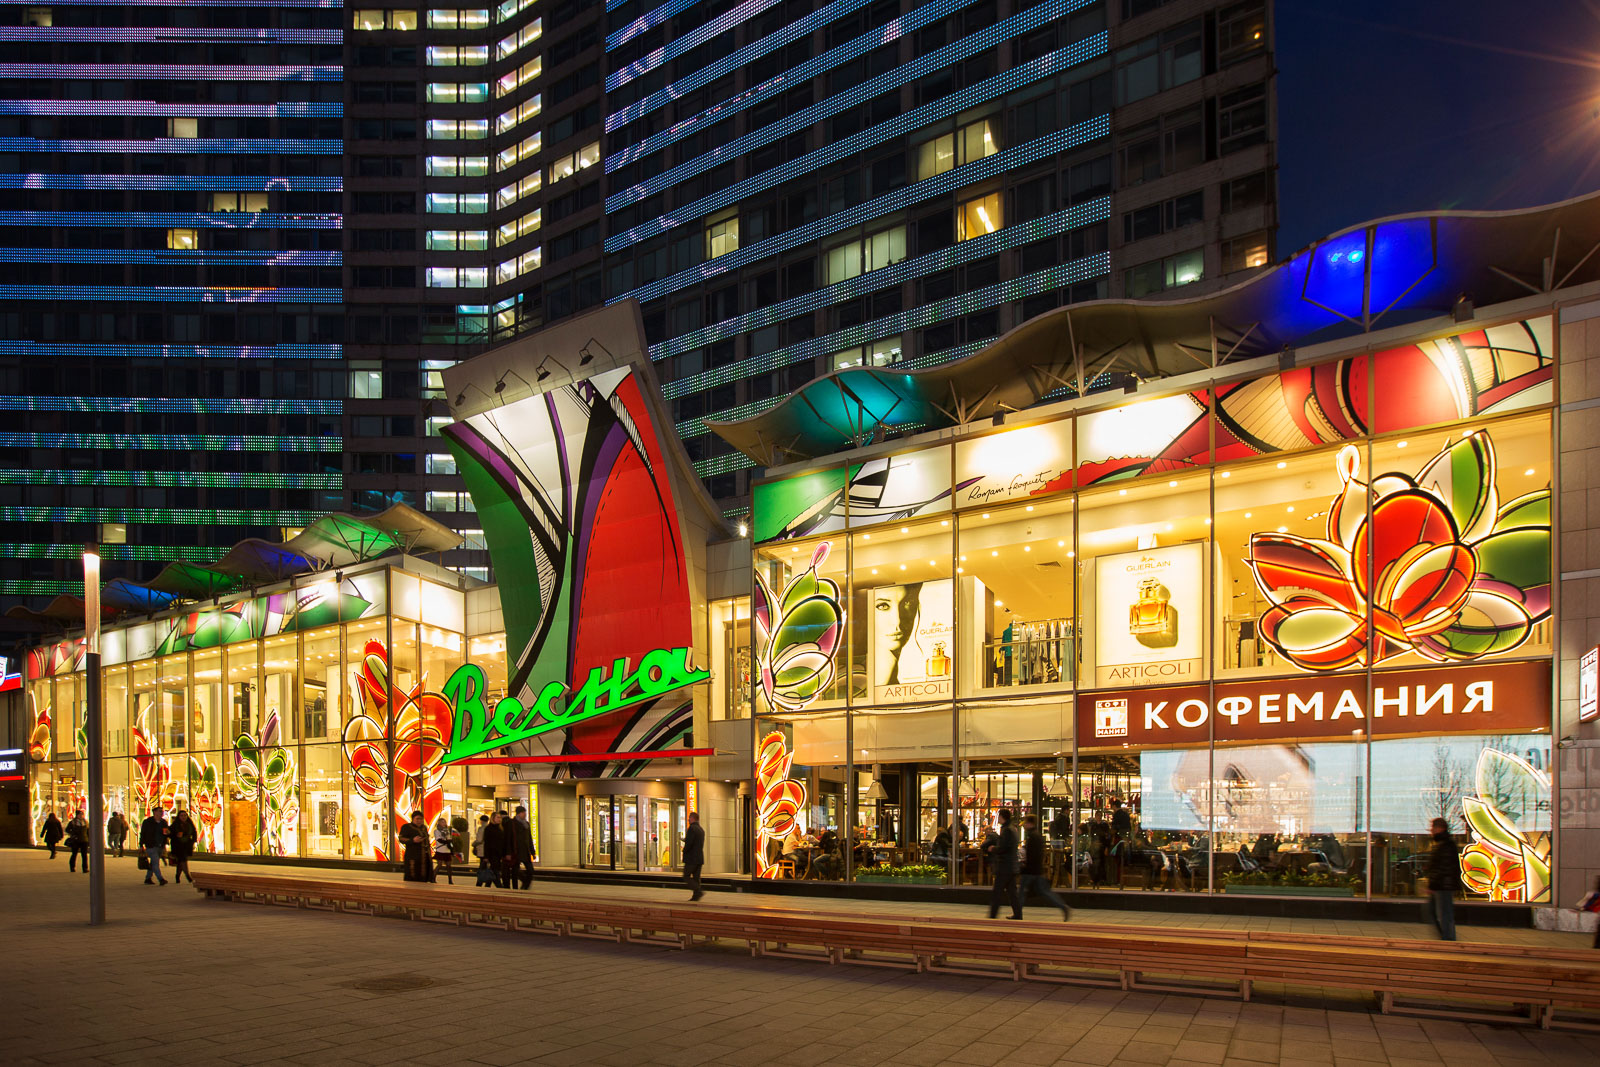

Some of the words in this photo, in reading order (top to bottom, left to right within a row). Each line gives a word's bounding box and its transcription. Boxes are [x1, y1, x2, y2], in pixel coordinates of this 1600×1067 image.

[1126, 560, 1171, 572] GUERLAIN
[1109, 662, 1191, 679] ARTICOLI
[884, 682, 950, 697] ARTICOLI
[441, 646, 713, 766] Весна
[1144, 681, 1494, 730] КОФЕМАНИЯ
[1097, 728, 1126, 736] МАНИЯ
